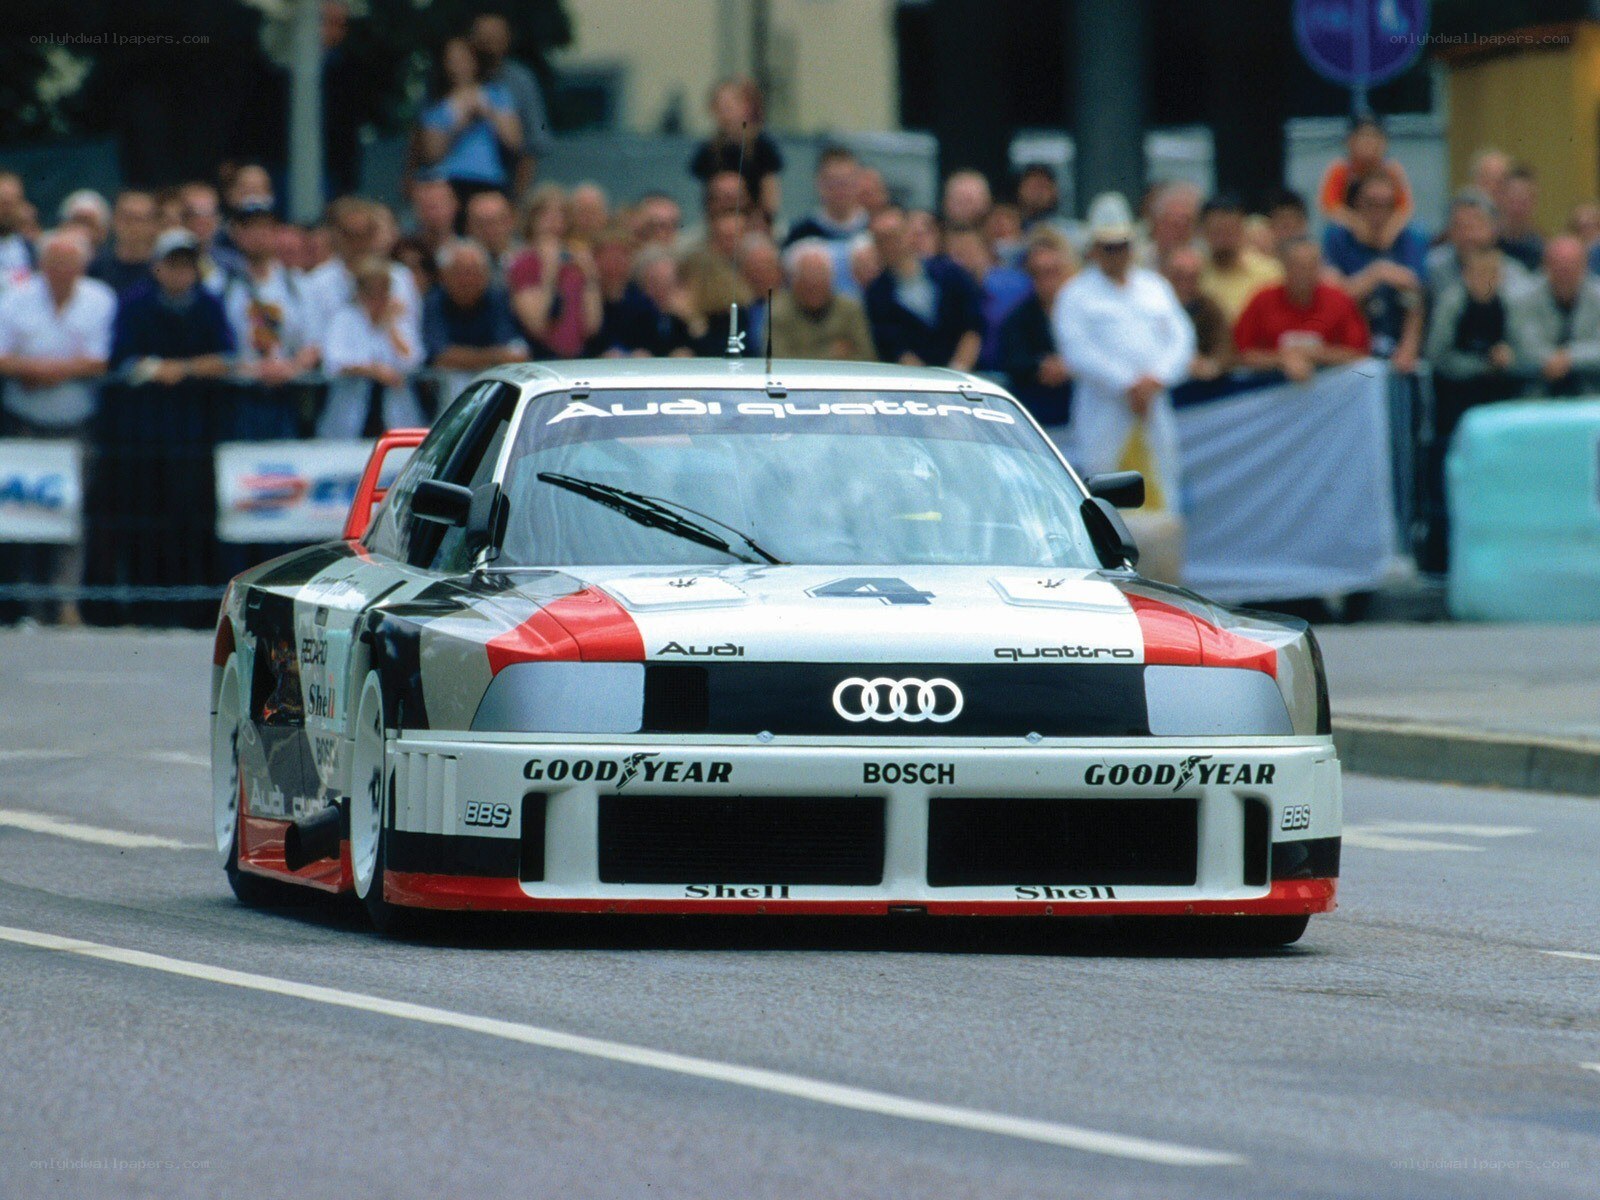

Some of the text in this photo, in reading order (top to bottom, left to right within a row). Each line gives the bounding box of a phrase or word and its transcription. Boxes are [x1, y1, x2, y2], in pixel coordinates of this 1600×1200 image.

[545, 398, 1016, 426] Audi quattro
[656, 641, 745, 657] Audi
[994, 645, 1135, 662] quattro
[307, 683, 336, 719] Shell
[863, 762, 955, 785] BOSCH
[465, 801, 512, 828] BBS
[1280, 804, 1311, 831] BBS
[685, 884, 790, 899] Shell
[1014, 886, 1117, 900] Shell
